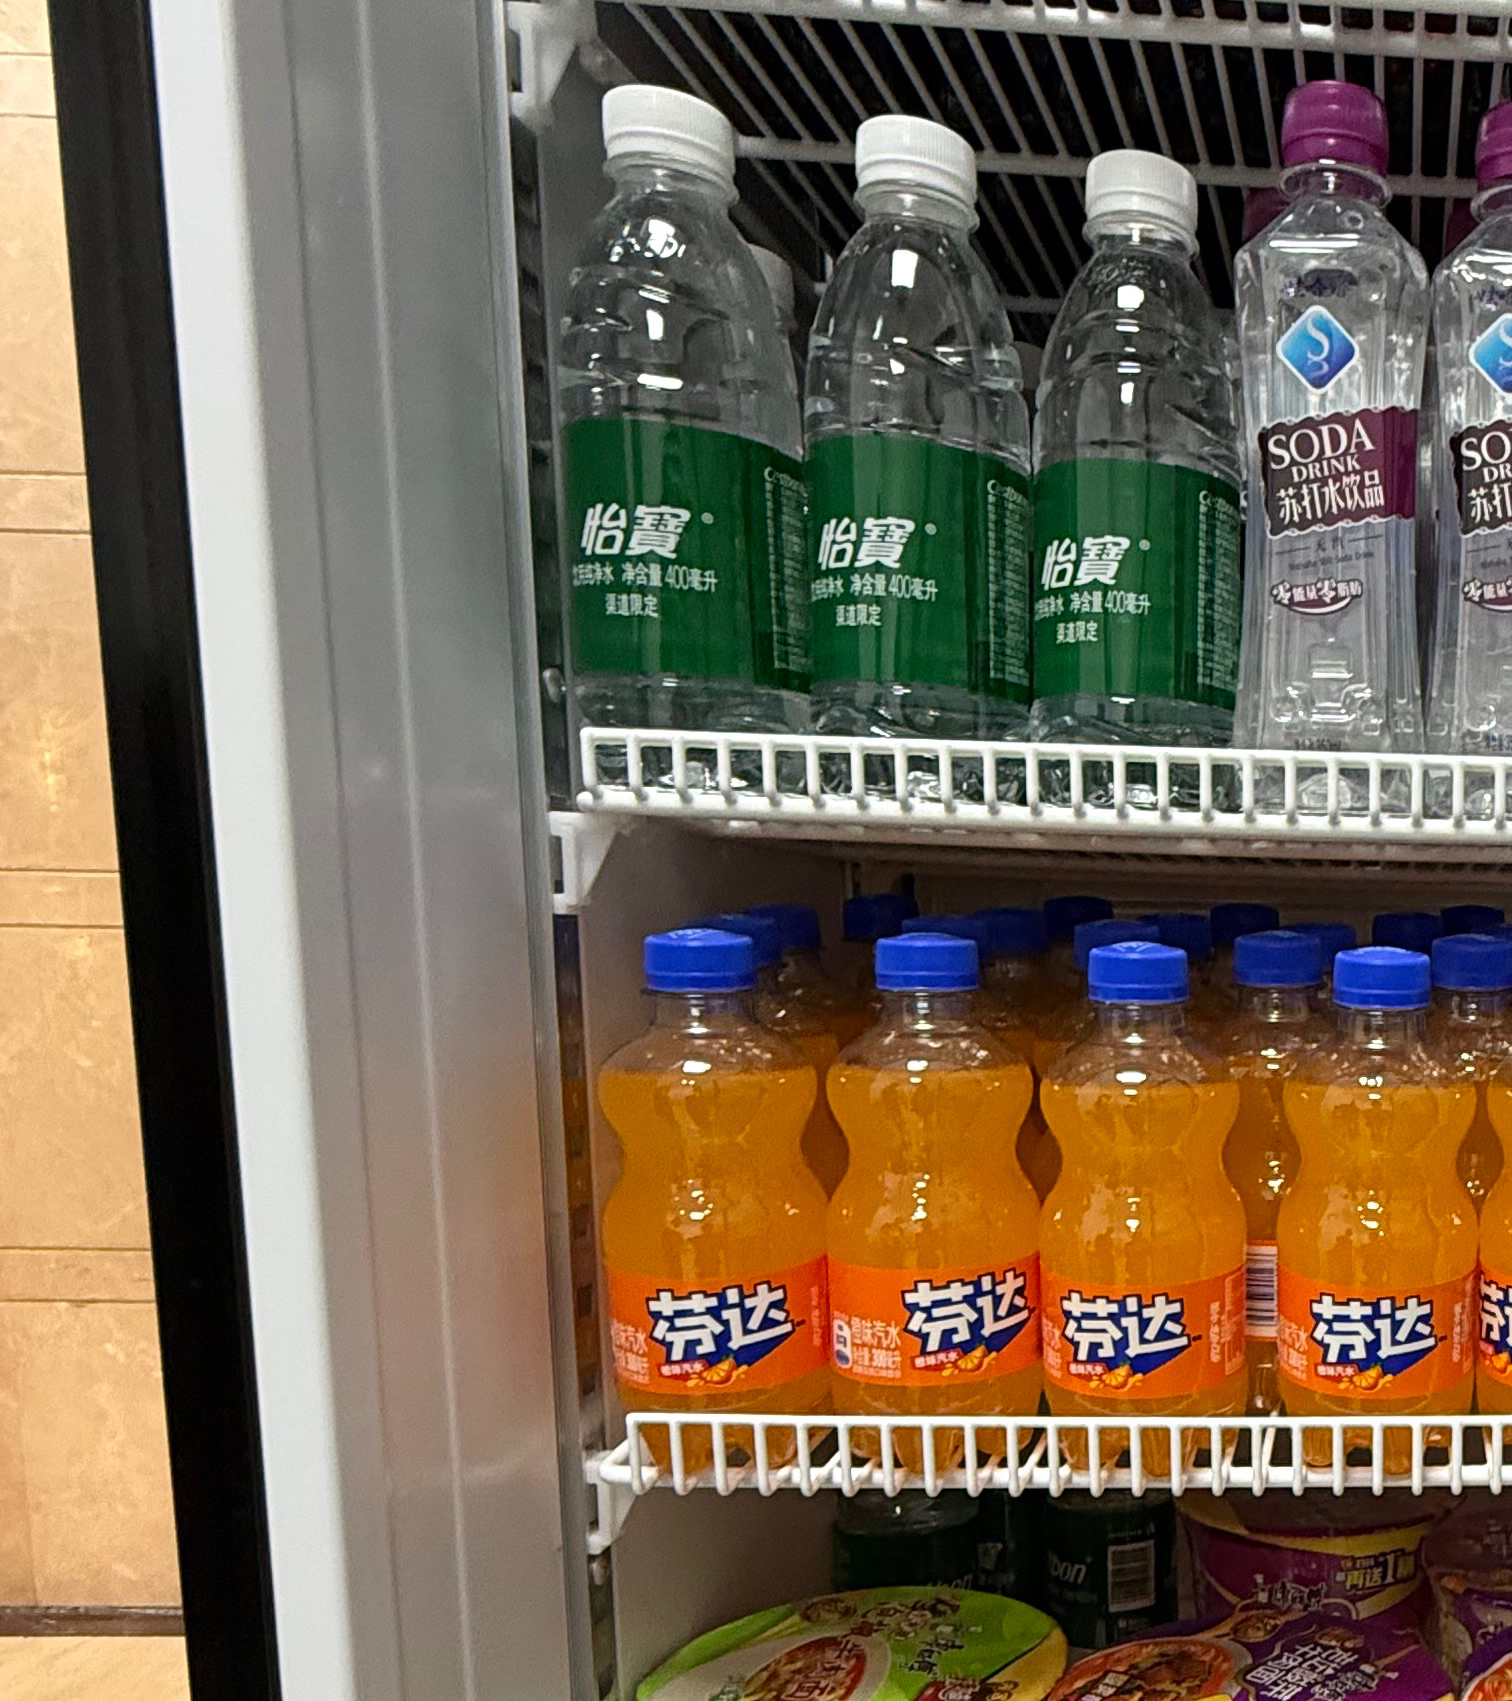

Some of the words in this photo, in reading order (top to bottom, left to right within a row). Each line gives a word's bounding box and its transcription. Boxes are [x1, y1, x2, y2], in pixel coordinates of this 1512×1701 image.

[1268, 418, 1377, 470] SODA
[1292, 454, 1361, 483] DRINK
[1277, 469, 1385, 524] 苏打水饮品
[647, 1281, 795, 1362] 芬达
[903, 1270, 1030, 1352] 芬达
[1062, 1290, 1190, 1361] 芬达
[1310, 1295, 1437, 1363] 芬达
[1245, 1643, 1324, 1686] 牛肉面
[1259, 1646, 1360, 1701] 老坛酸菜
